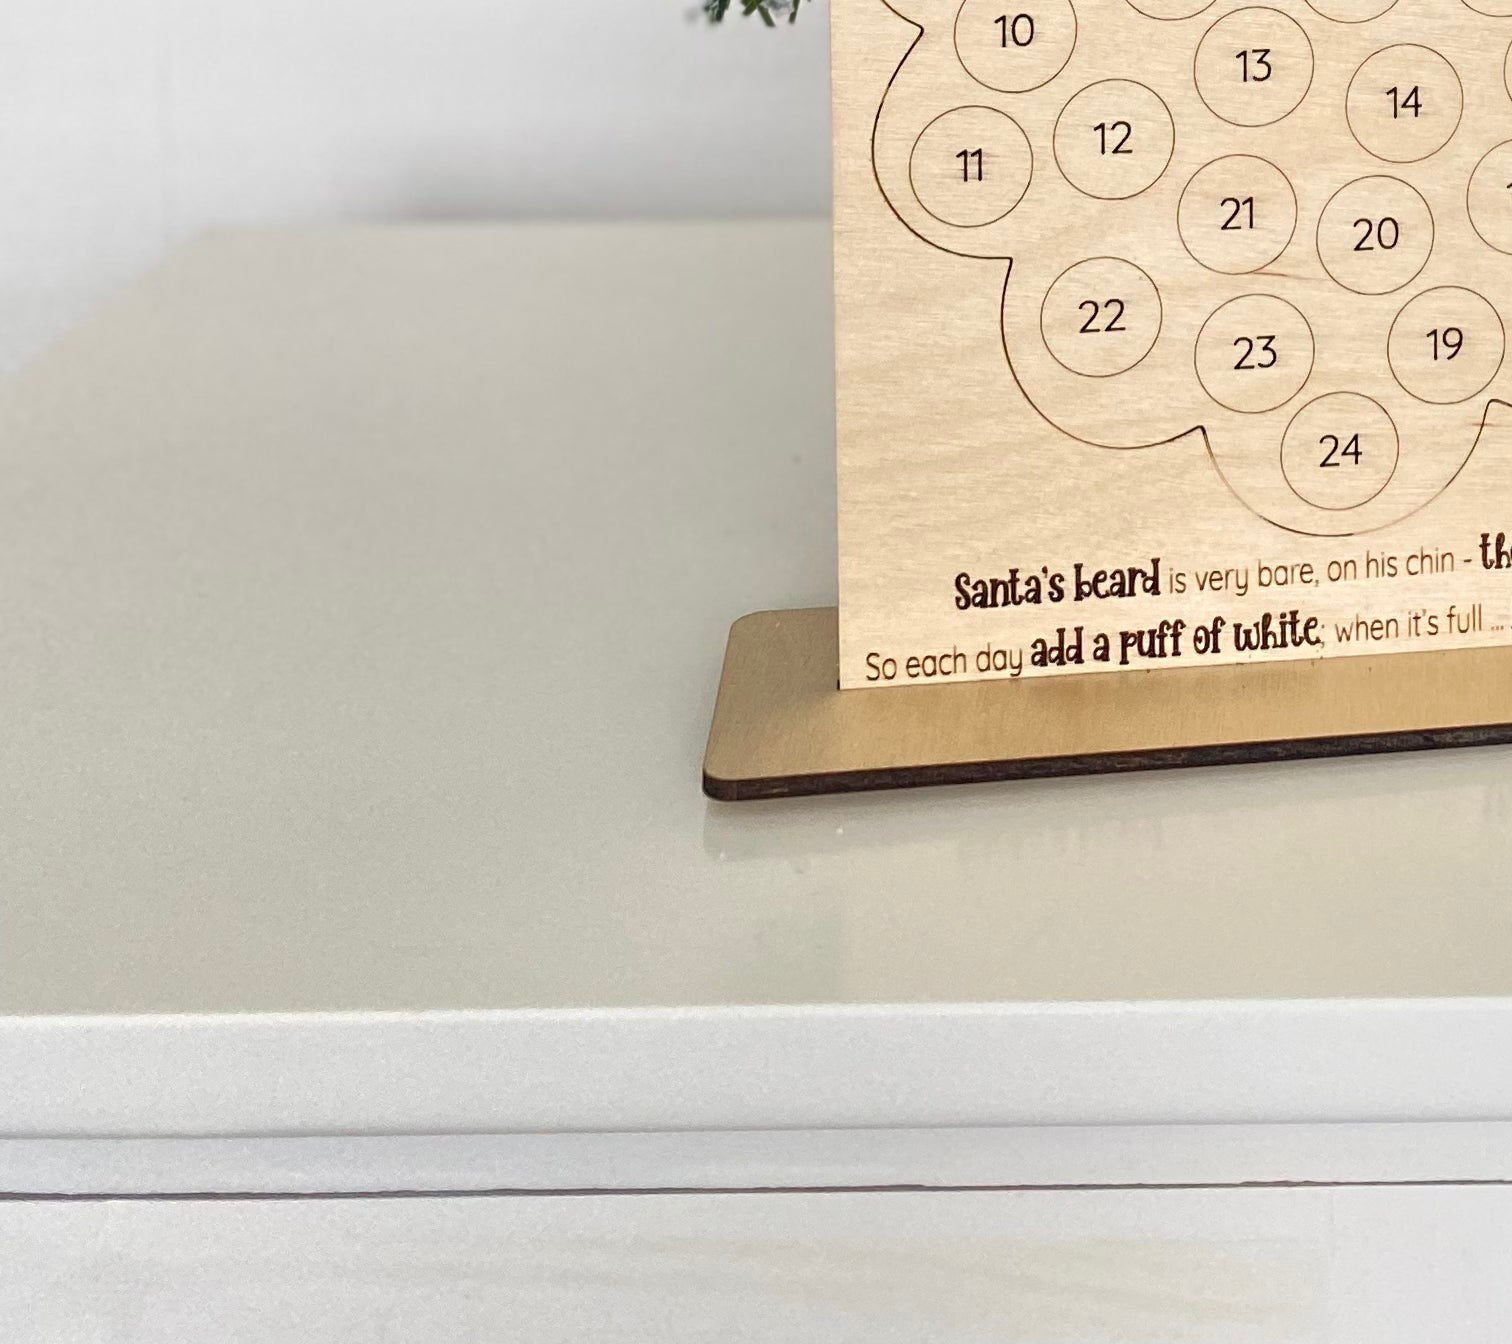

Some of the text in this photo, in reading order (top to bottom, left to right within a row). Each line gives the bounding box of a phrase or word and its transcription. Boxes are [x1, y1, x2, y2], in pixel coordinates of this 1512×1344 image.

[992, 12, 1036, 49] 10
[1234, 47, 1273, 84] 13
[1384, 84, 1424, 121] 14
[1092, 119, 1135, 157] 12
[954, 146, 984, 184] 11
[1219, 195, 1255, 232] 21
[1352, 215, 1401, 253] 20
[1077, 297, 1128, 335] 22
[1232, 333, 1279, 372] 23
[1424, 325, 1465, 362] 19
[1318, 431, 1364, 469] 24
[954, 565, 1065, 610] Santa's
[1073, 557, 1162, 603] beard
[1168, 567, 1187, 595] is
[1194, 567, 1249, 598] very
[1257, 557, 1321, 588] bare,
[1326, 558, 1358, 583] on
[1365, 549, 1399, 579] his
[1405, 545, 1456, 576] chin
[865, 651, 898, 682] So
[905, 644, 968, 678] each
[975, 641, 1024, 678] day
[1030, 625, 1086, 668] add
[1092, 632, 1111, 664] a
[1119, 618, 1187, 666] puff
[1193, 616, 1227, 655] of
[1334, 613, 1400, 643] when
[1407, 608, 1440, 639] it's
[1446, 603, 1483, 635] full
